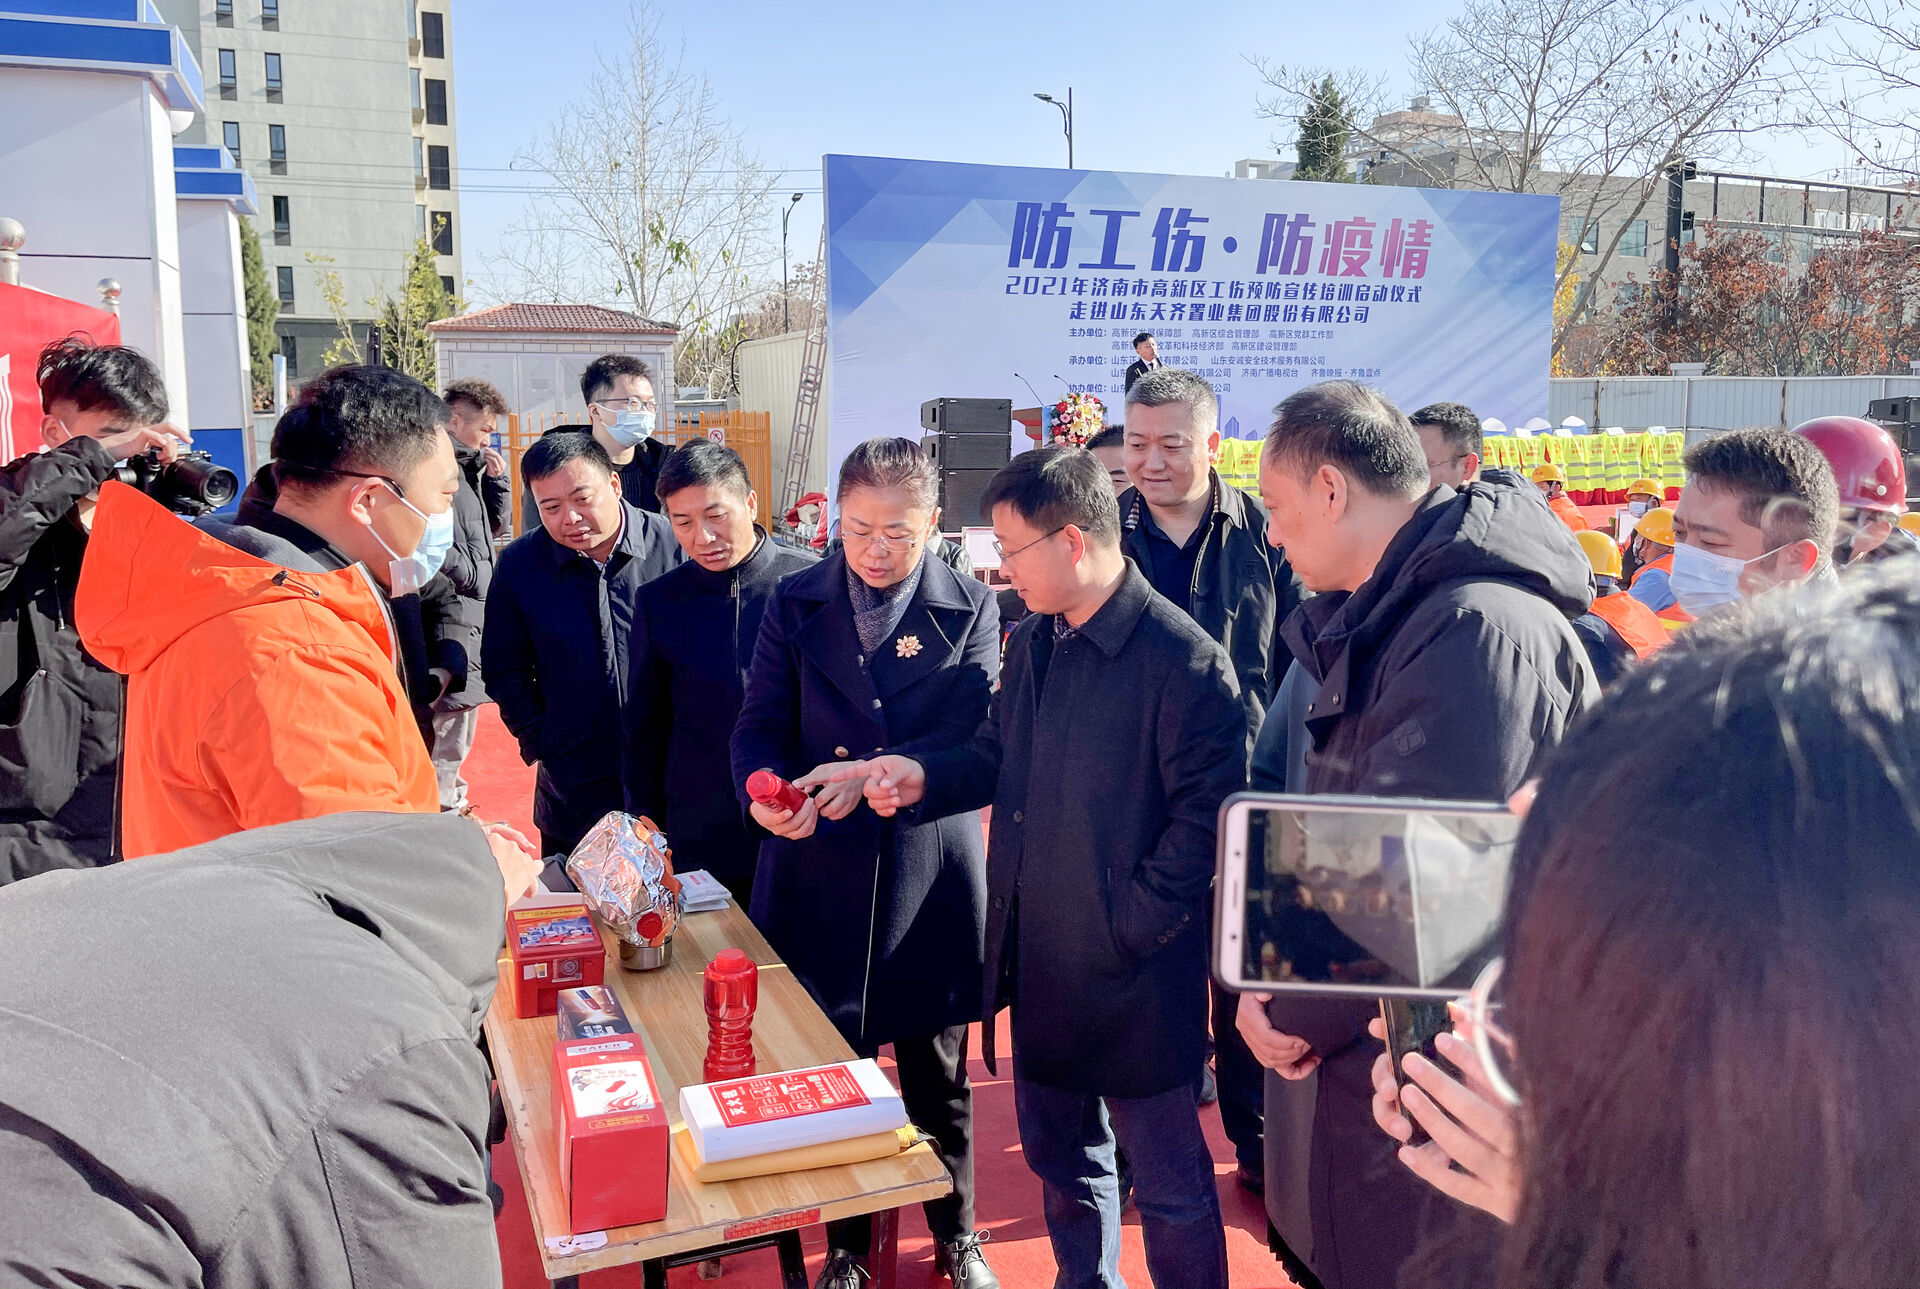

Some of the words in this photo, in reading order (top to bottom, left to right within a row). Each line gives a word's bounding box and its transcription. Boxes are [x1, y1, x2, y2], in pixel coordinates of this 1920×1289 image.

[1008, 202, 1434, 279] 防工伤·防疫情
[1005, 275, 1422, 303] 2021年济南市高新区工伤预防宣传培训启动仪式
[1069, 301, 1370, 324] 走进山东天齐置业集团股份有限公司
[1192, 329, 1260, 339] 高新区综合管理部
[1269, 329, 1334, 339] 高新区党群工作部
[1111, 341, 1224, 351] 高新区改革和科技经济部
[1231, 342, 1298, 351] 高新区建设管理部
[1211, 356, 1326, 365] 山东安诚安全技术服务有限公司
[1241, 368, 1299, 377] 济南广播电视台
